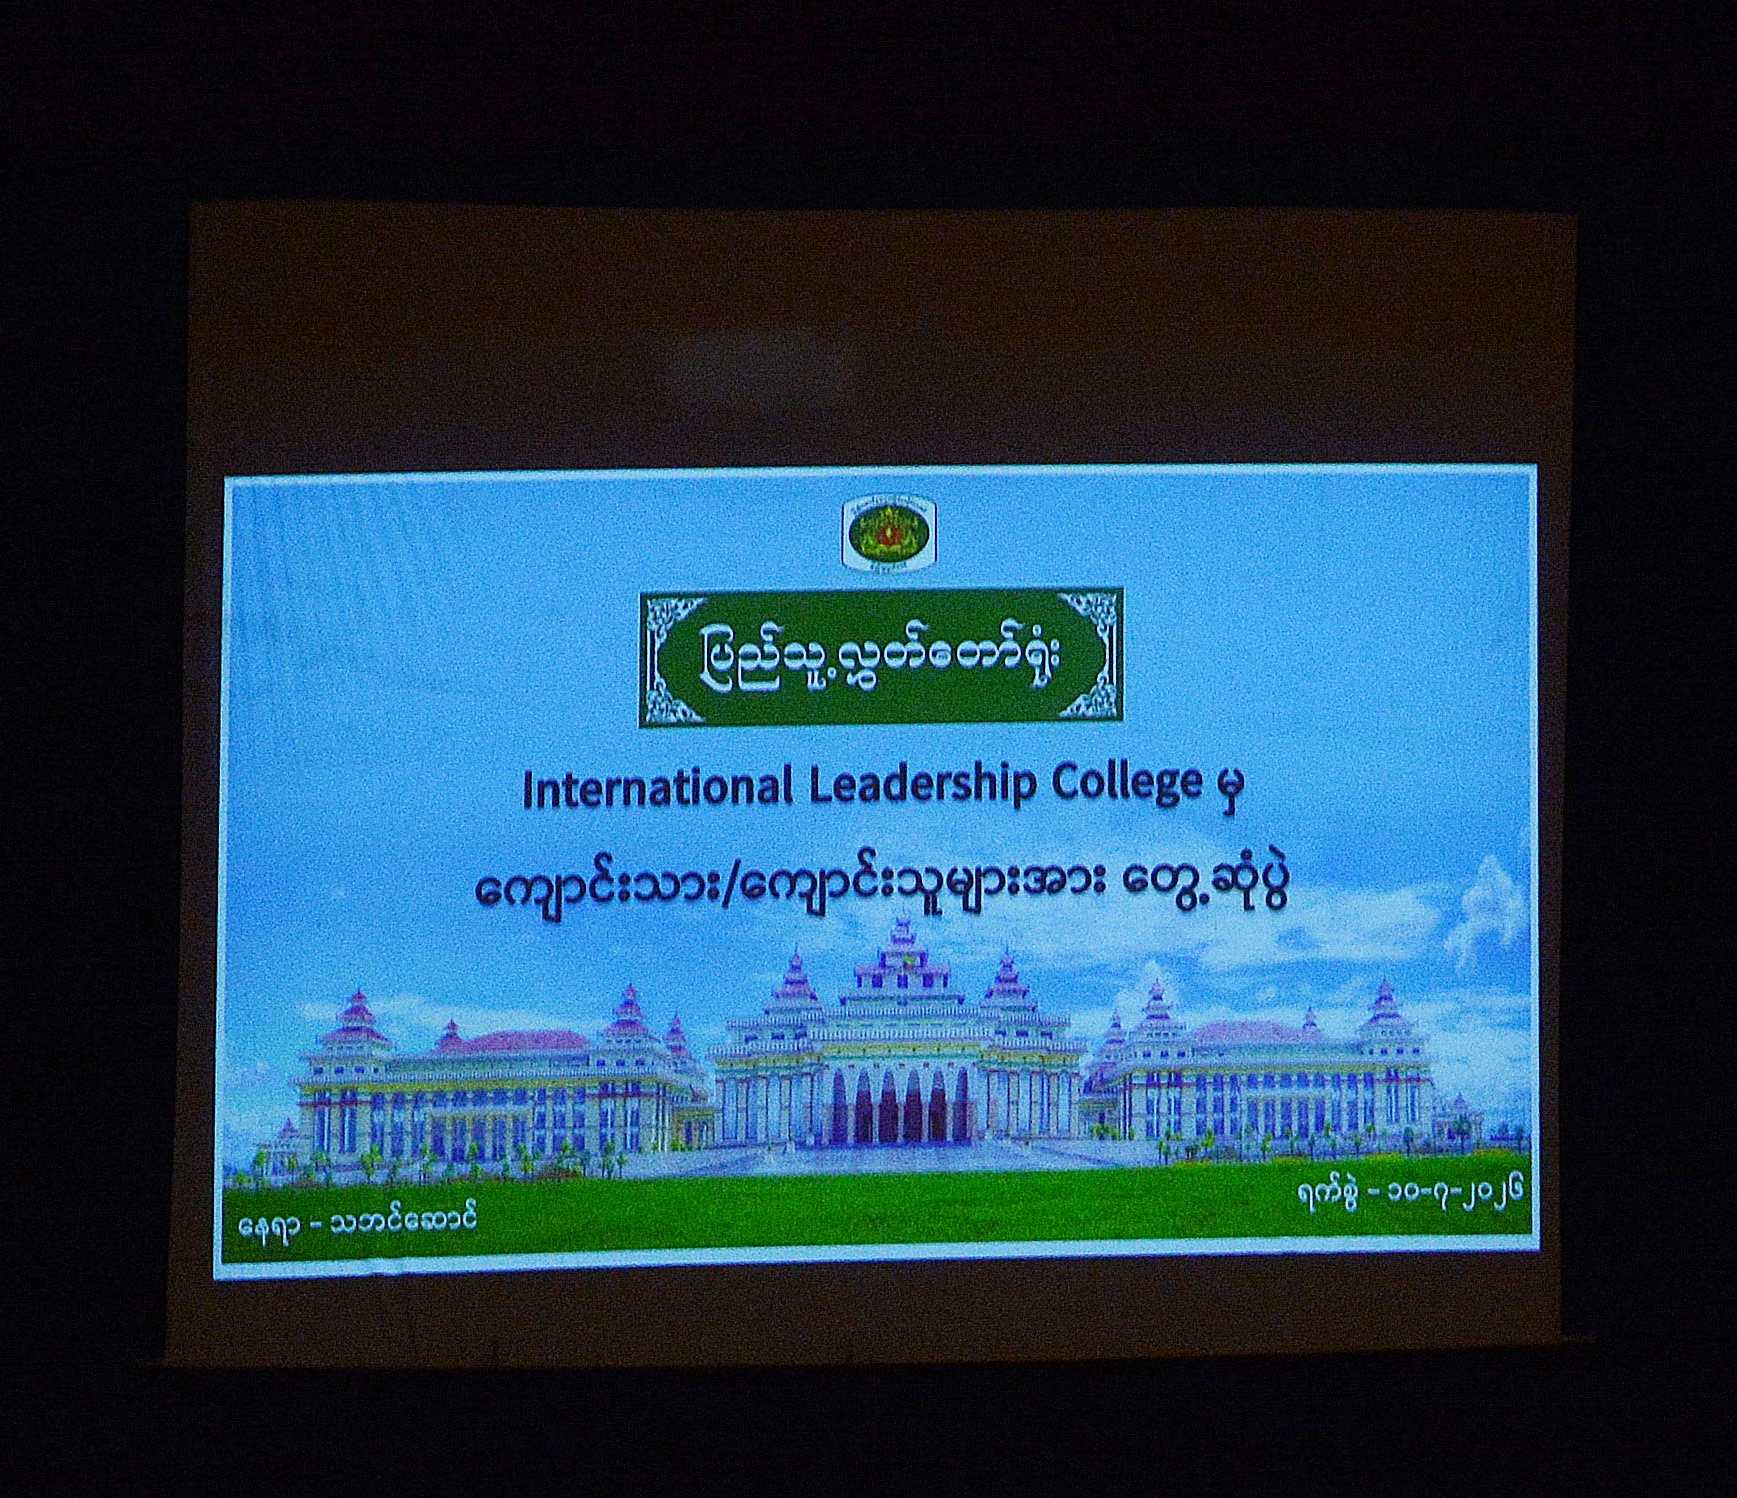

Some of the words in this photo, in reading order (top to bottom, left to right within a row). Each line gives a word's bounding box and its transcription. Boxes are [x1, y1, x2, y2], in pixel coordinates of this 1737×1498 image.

[700, 618, 1061, 693] ပြည်သူ့လွှတ်တော်ရုံး
[524, 763, 794, 809] International
[811, 760, 1038, 811] Leadership
[1053, 758, 1204, 809] College
[1217, 768, 1246, 817] မှ
[1122, 844, 1291, 912] တွေ့ဆုံပွဲ
[238, 1216, 301, 1247] နေရာ
[330, 1197, 478, 1233] သဘင်ဆောင်
[1297, 1171, 1359, 1214] ရက်စွဲ
